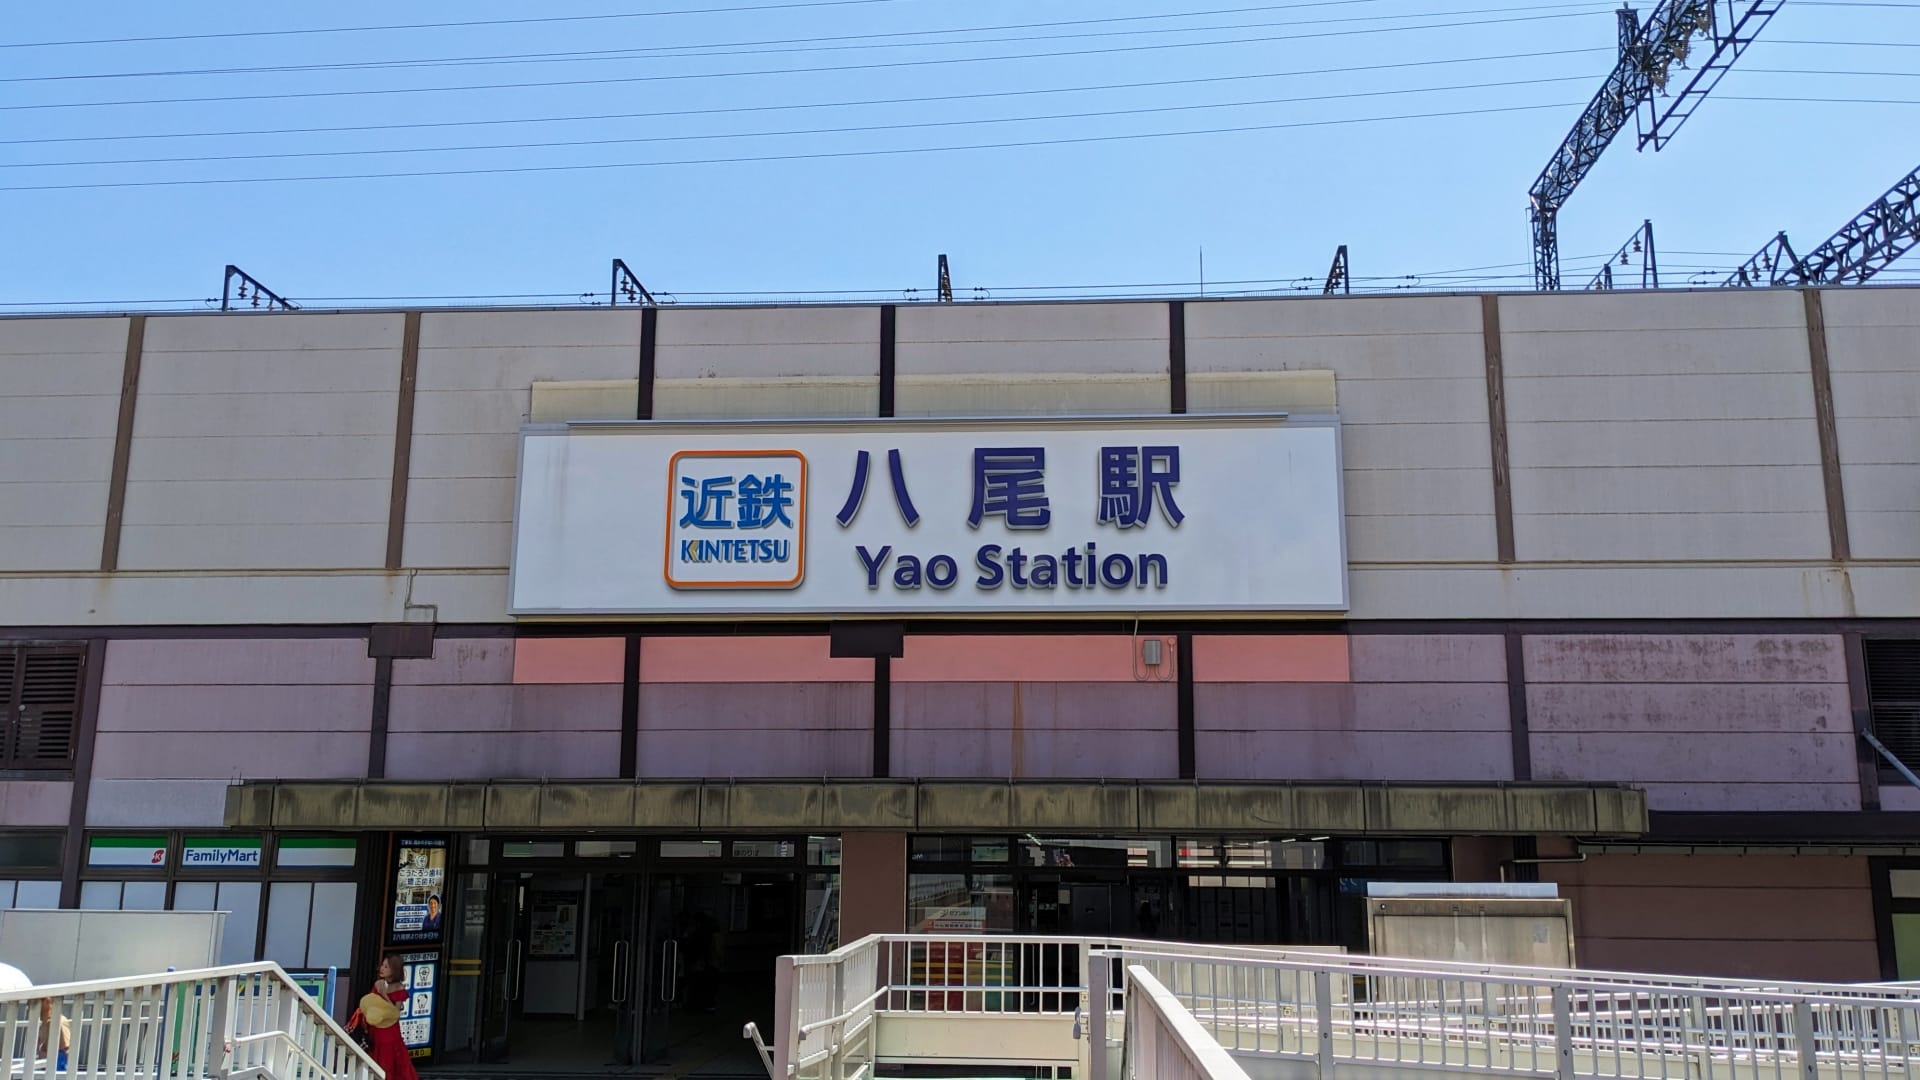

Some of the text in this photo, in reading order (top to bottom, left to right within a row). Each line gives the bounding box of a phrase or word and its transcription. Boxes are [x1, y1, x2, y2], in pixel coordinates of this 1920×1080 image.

[679, 473, 794, 529] 近鉄
[836, 445, 1185, 530] 八尾駅
[681, 539, 789, 563] KINTETSU
[855, 542, 1168, 589] Yao Station
[185, 849, 258, 863] FamilyMart
